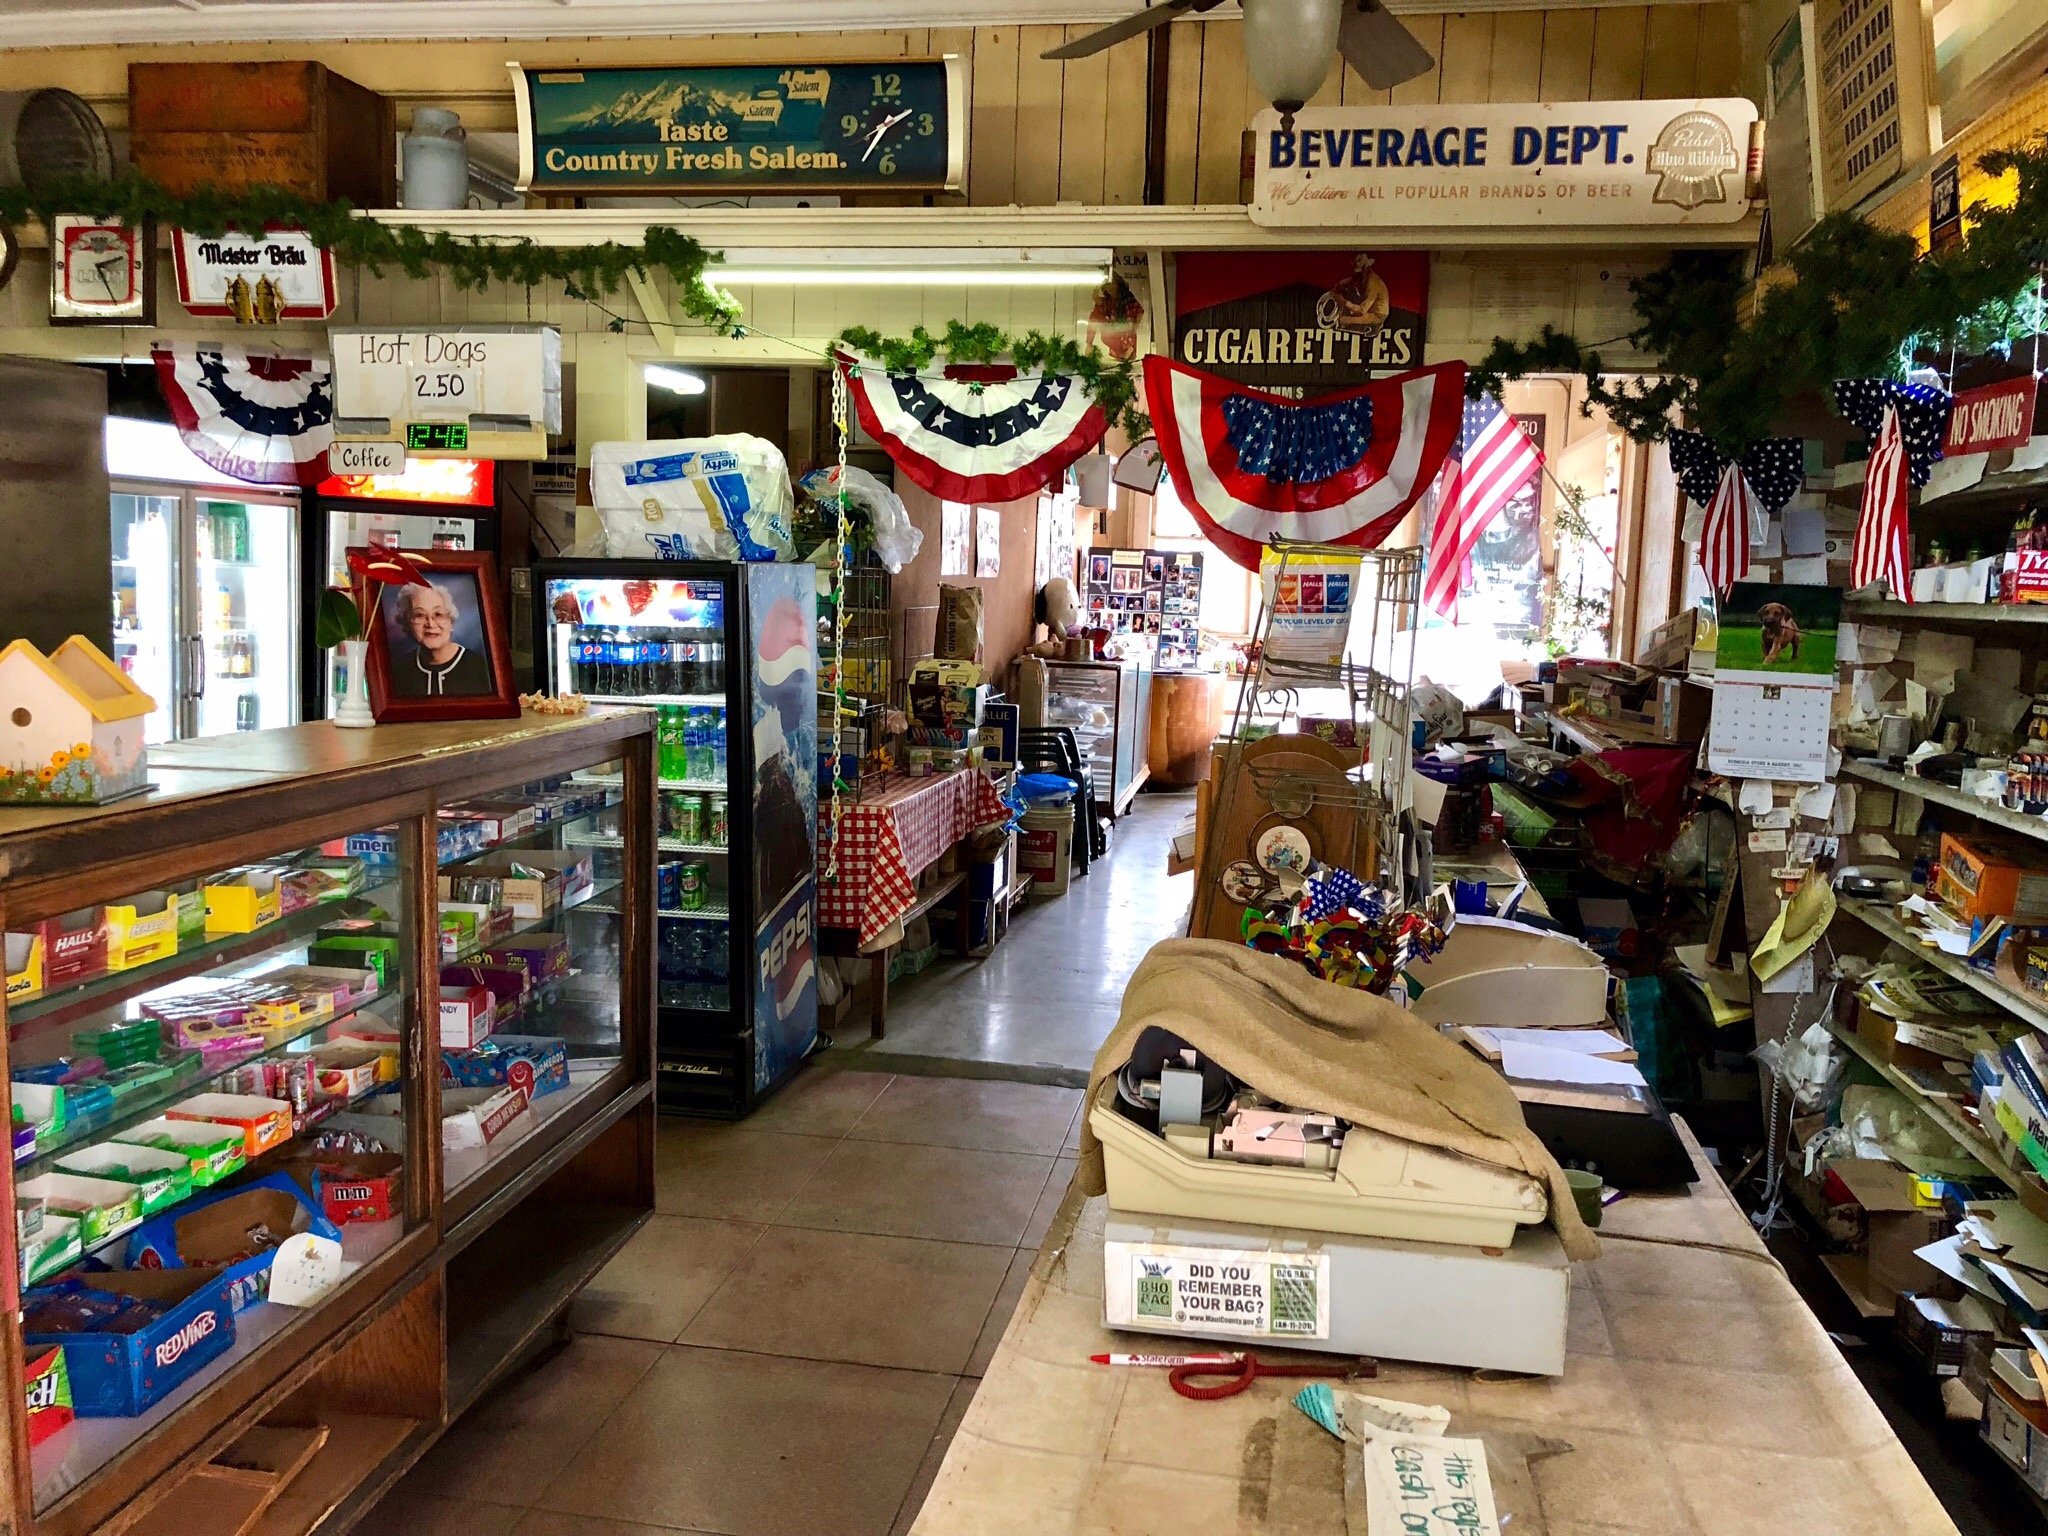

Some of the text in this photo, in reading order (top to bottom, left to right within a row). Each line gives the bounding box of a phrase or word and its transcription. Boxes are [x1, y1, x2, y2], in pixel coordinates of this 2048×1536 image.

[792, 79, 820, 93] Salem
[871, 74, 901, 96] 12
[747, 104, 775, 118] Salem
[655, 117, 728, 142] Taste
[841, 114, 934, 136] 9 3
[1269, 124, 1635, 169] BEVERAGE DEPT.
[545, 143, 847, 174] Country Fresh Salem.
[879, 153, 896, 175] 6
[1267, 183, 1633, 204] We feature ALL POPULAR BRANDS OF BEER
[198, 243, 307, 266] Meister Bräu
[360, 334, 487, 369] Hot Dogs
[1183, 327, 1412, 365] CIGARETTES
[415, 374, 465, 399] 2.50
[1949, 392, 2025, 446] NO SMOKING
[342, 448, 392, 468] Coffee
[705, 458, 737, 471] Hefty
[55, 931, 93, 953] HALLS
[760, 900, 812, 992] PEPSI
[1189, 1264, 1251, 1281] DID YOU
[1140, 1293, 1170, 1306] BAG
[1178, 1280, 1262, 1299] REMEMBER
[1181, 1295, 1220, 1312] YOUR
[1224, 1298, 1265, 1315] BAG?
[1390, 1445, 1436, 1501] Cash
[1441, 1451, 1474, 1491] this
